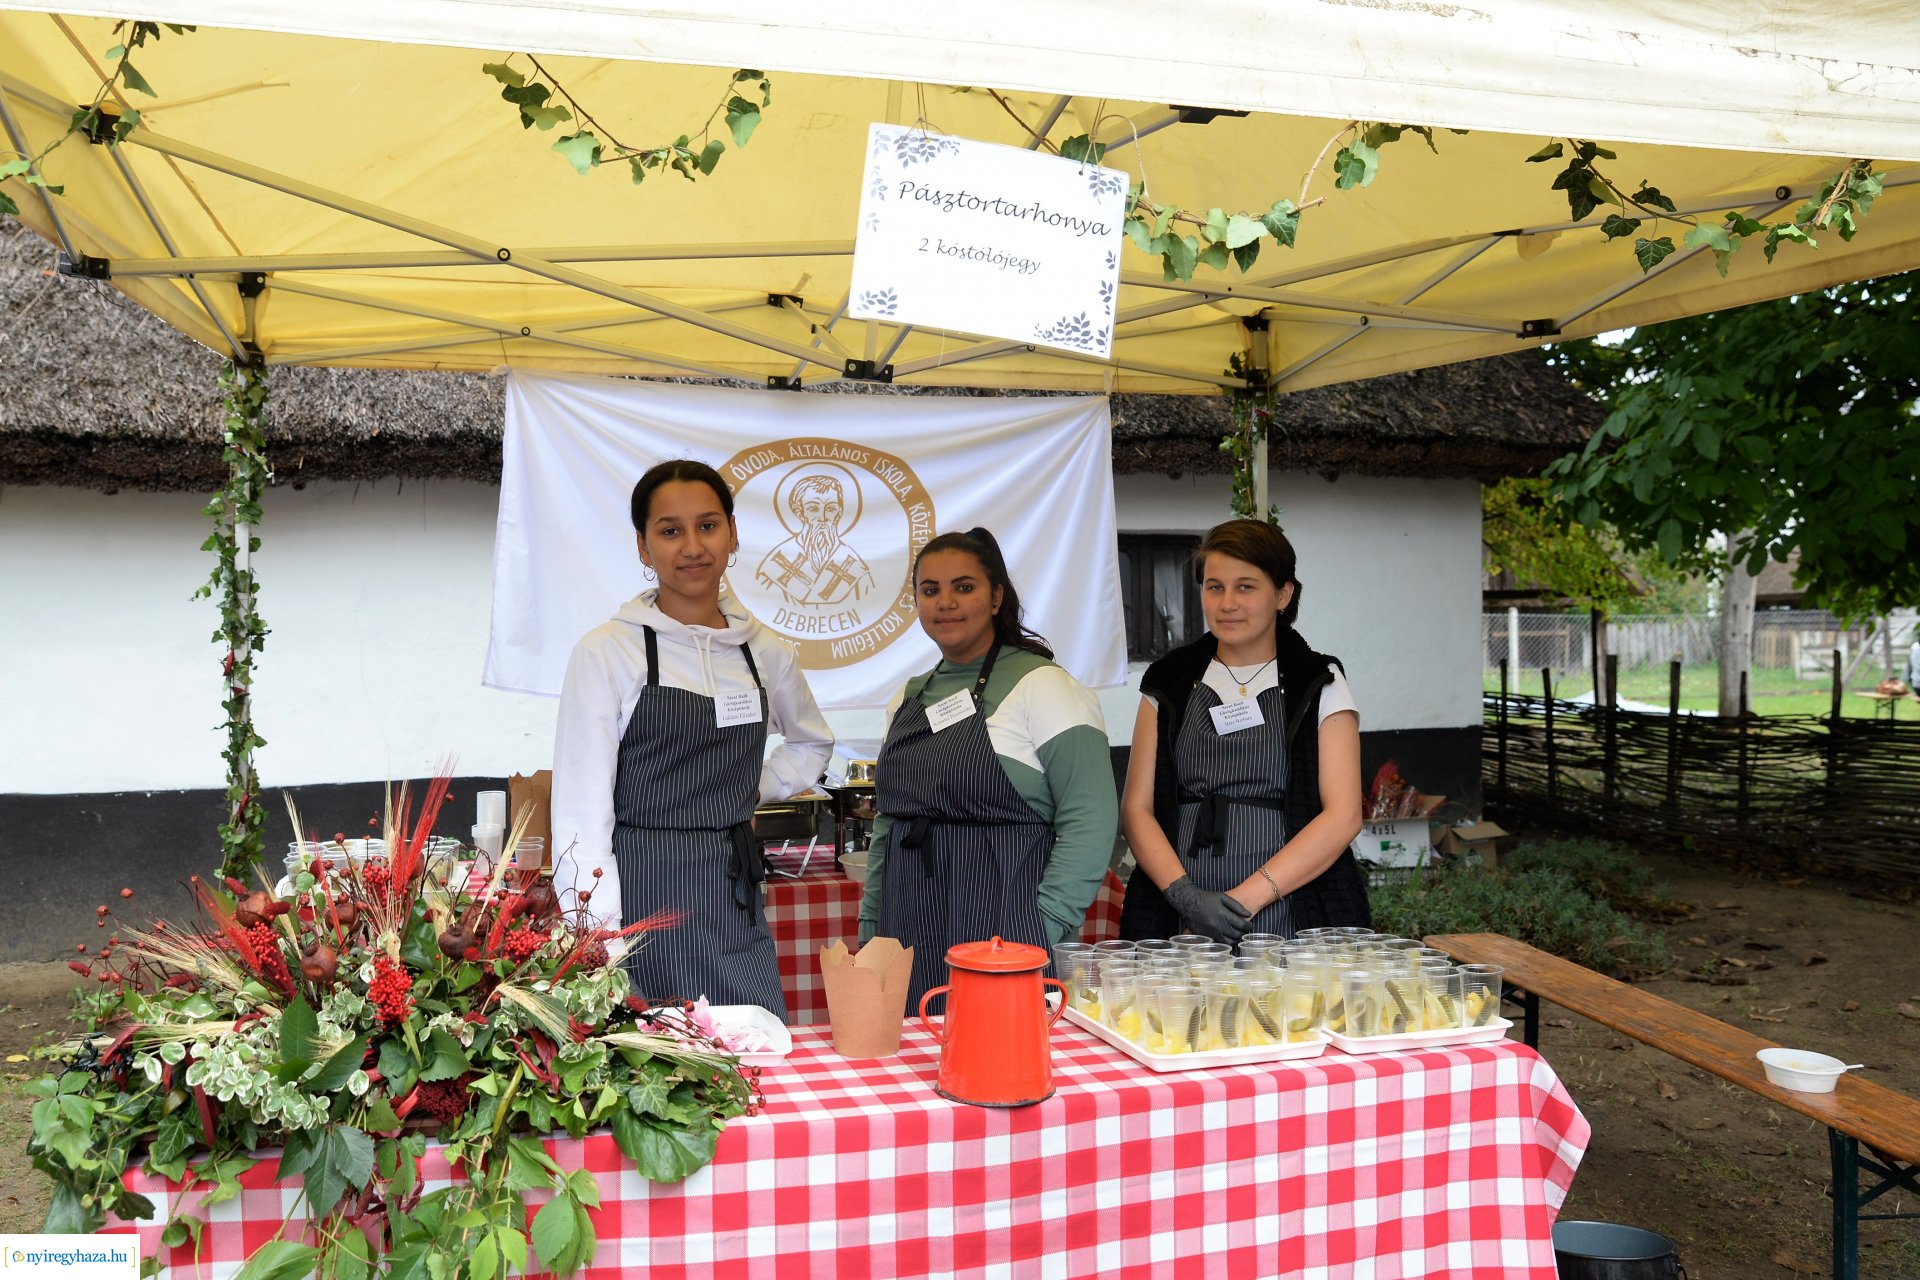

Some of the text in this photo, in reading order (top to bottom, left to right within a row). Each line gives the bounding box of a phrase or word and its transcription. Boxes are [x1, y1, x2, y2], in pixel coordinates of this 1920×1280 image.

[898, 180, 1112, 238] Pásztortarhonya
[918, 237, 929, 253] 2
[731, 448, 785, 481] ÓVODA,
[788, 442, 870, 465] ÁLTALÁNOS
[872, 457, 914, 503] ISKOLA,
[772, 607, 863, 634] DEBRECEN
[831, 611, 904, 660] KOLLÉGIUM
